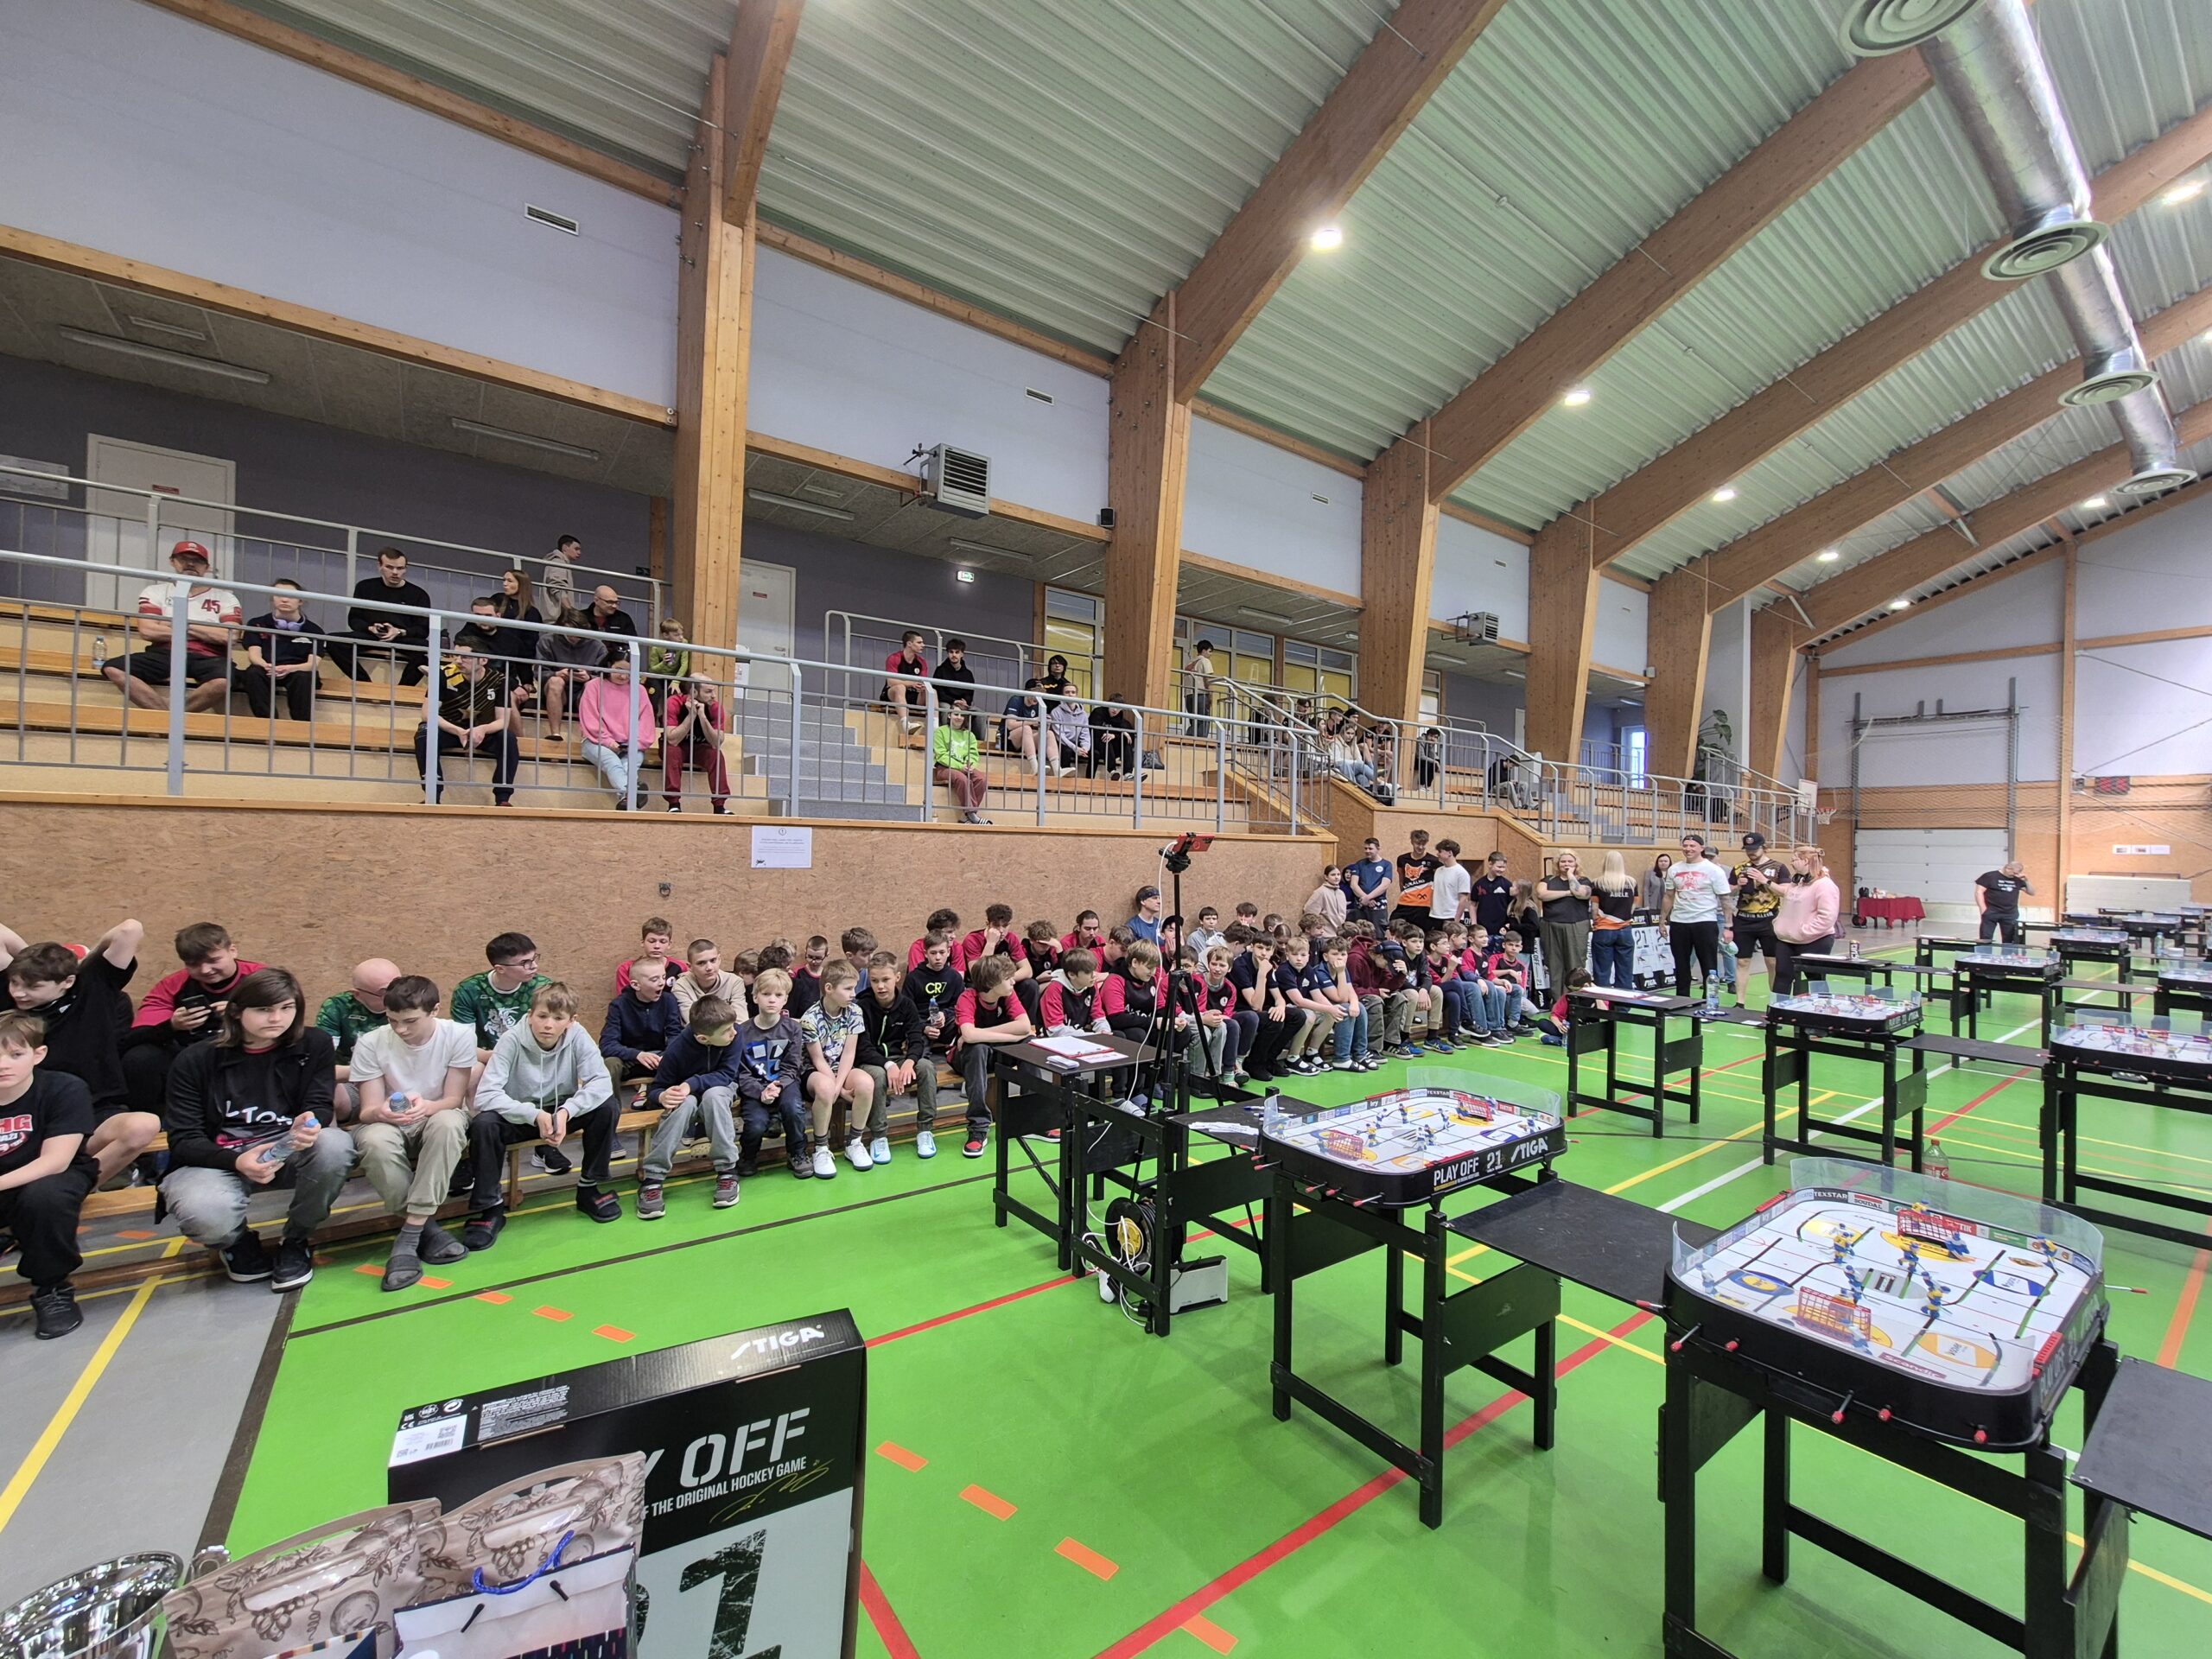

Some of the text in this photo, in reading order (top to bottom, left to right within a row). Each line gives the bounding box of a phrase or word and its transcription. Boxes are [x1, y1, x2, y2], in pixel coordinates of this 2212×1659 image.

[201, 599, 221, 613] 45
[486, 688, 496, 701] 5
[925, 982, 947, 994] CR7
[1433, 1163, 1458, 1185] PLAY
[1460, 1157, 1480, 1177] OFF
[1486, 1150, 1503, 1170] 21
[1510, 1137, 1548, 1163] STIGA
[1814, 1191, 1847, 1199] TEXSTAR
[1853, 1198, 1883, 1210] SOUDAL
[731, 1326, 825, 1360] STIGA
[679, 1408, 810, 1488] OFF
[652, 1497, 674, 1517] THE
[676, 1484, 728, 1514] ORIGINAL
[731, 1467, 774, 1492] HOCKEY
[776, 1456, 807, 1477] GAME
